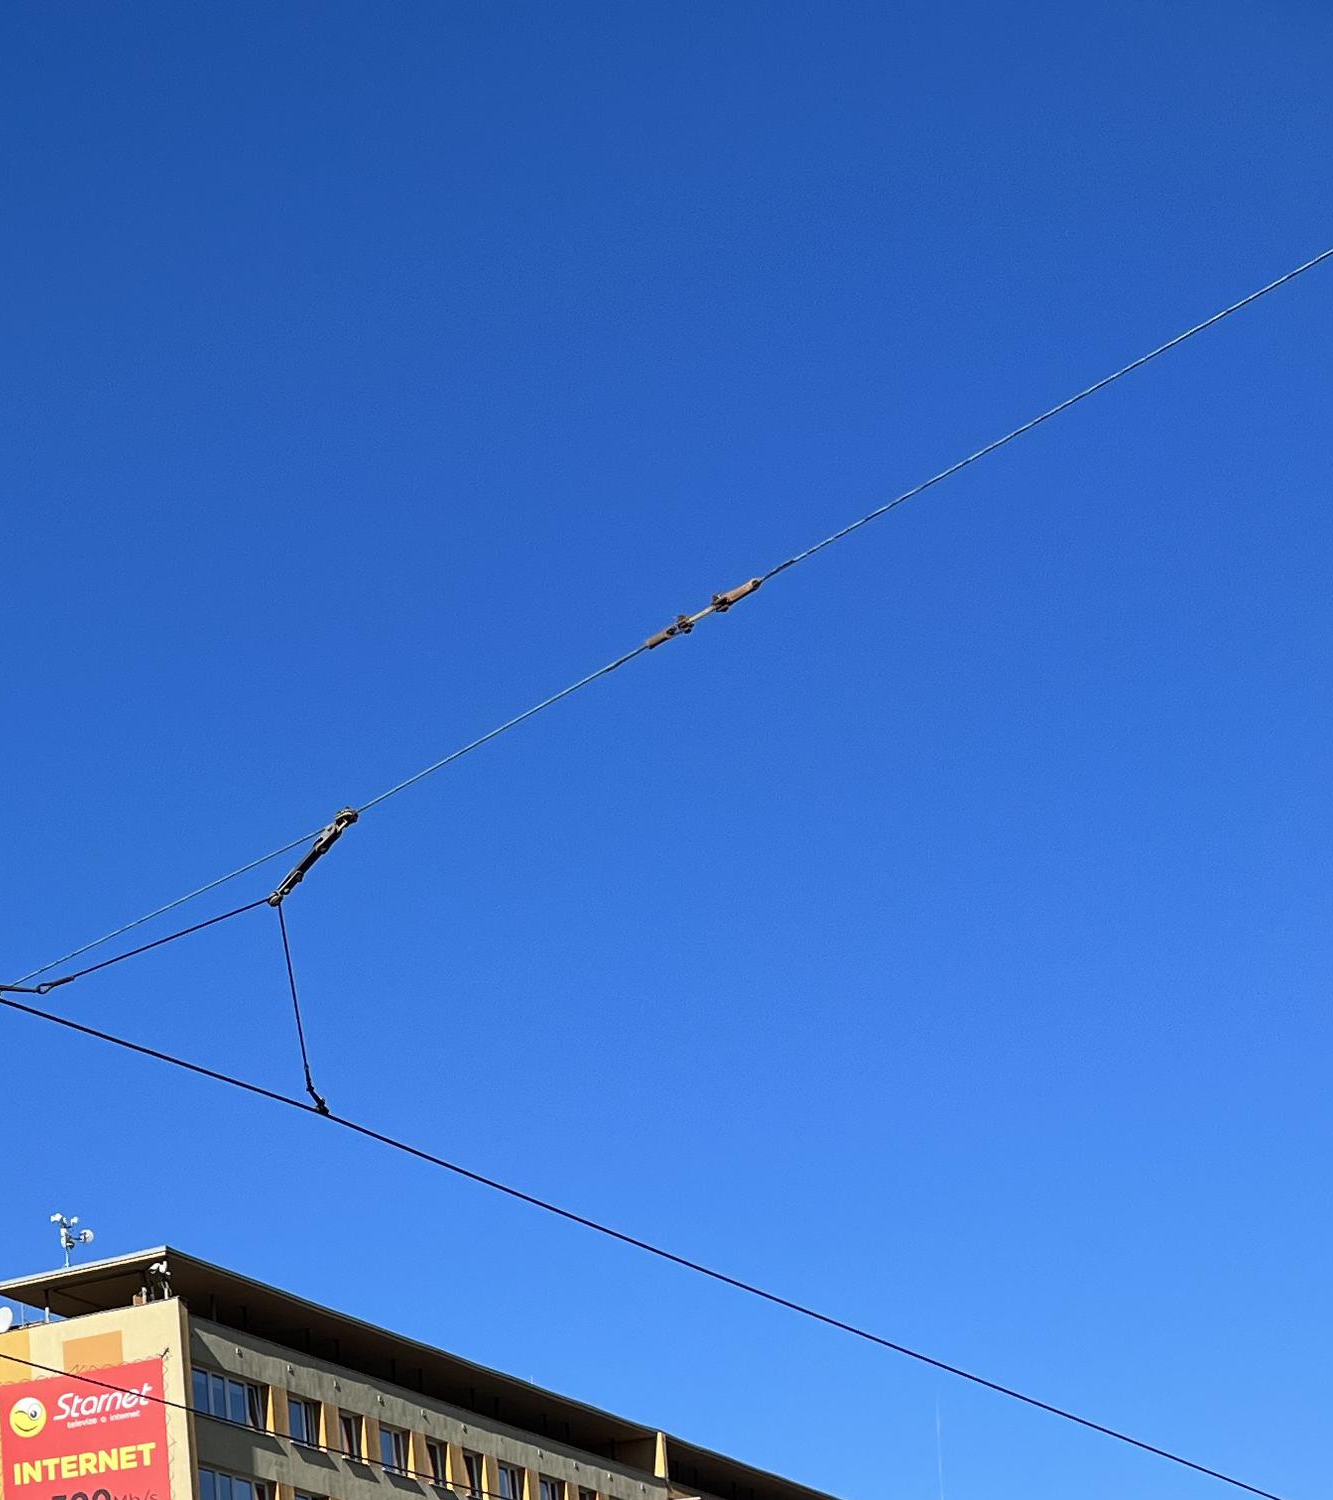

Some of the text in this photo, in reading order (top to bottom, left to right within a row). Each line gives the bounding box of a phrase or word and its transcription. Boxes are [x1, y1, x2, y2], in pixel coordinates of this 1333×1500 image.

[53, 1382, 153, 1421] Starnet
[110, 1410, 141, 1421] internet
[13, 1442, 156, 1485] INTERNET
